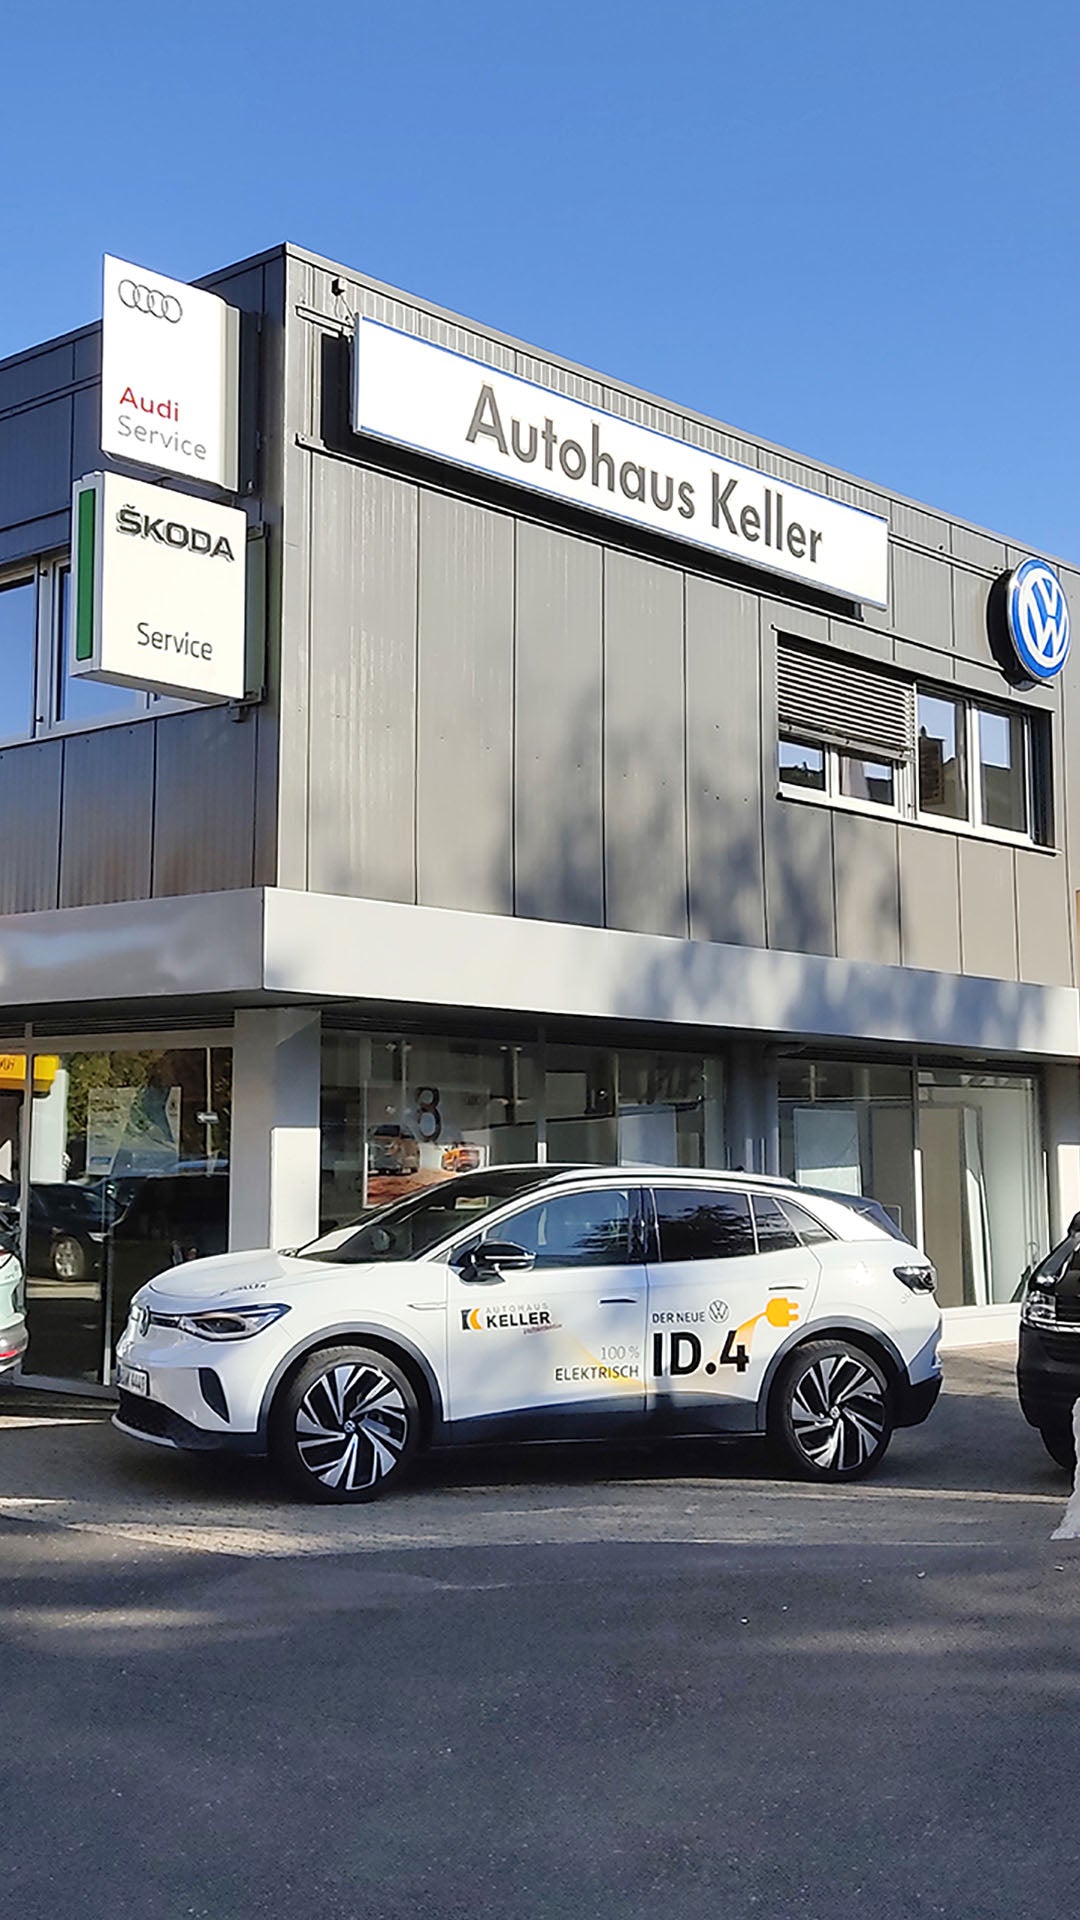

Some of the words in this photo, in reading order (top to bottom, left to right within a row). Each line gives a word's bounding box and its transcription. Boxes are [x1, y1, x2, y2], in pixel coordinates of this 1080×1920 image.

[119, 387, 179, 422] Audi
[117, 415, 207, 460] Service
[465, 383, 695, 519] Autohaus
[711, 470, 823, 563] Keller
[117, 504, 236, 561] ŠKODA
[137, 622, 213, 661] Service
[486, 1302, 549, 1315] AUTOHAUS
[486, 1311, 552, 1329] KELLER
[652, 1312, 675, 1324] DER
[676, 1311, 706, 1323] NEUE
[601, 1345, 626, 1361] 100
[628, 1345, 641, 1360] %
[653, 1330, 750, 1377] ID.4
[555, 1364, 640, 1381] ELEKTRISCH
